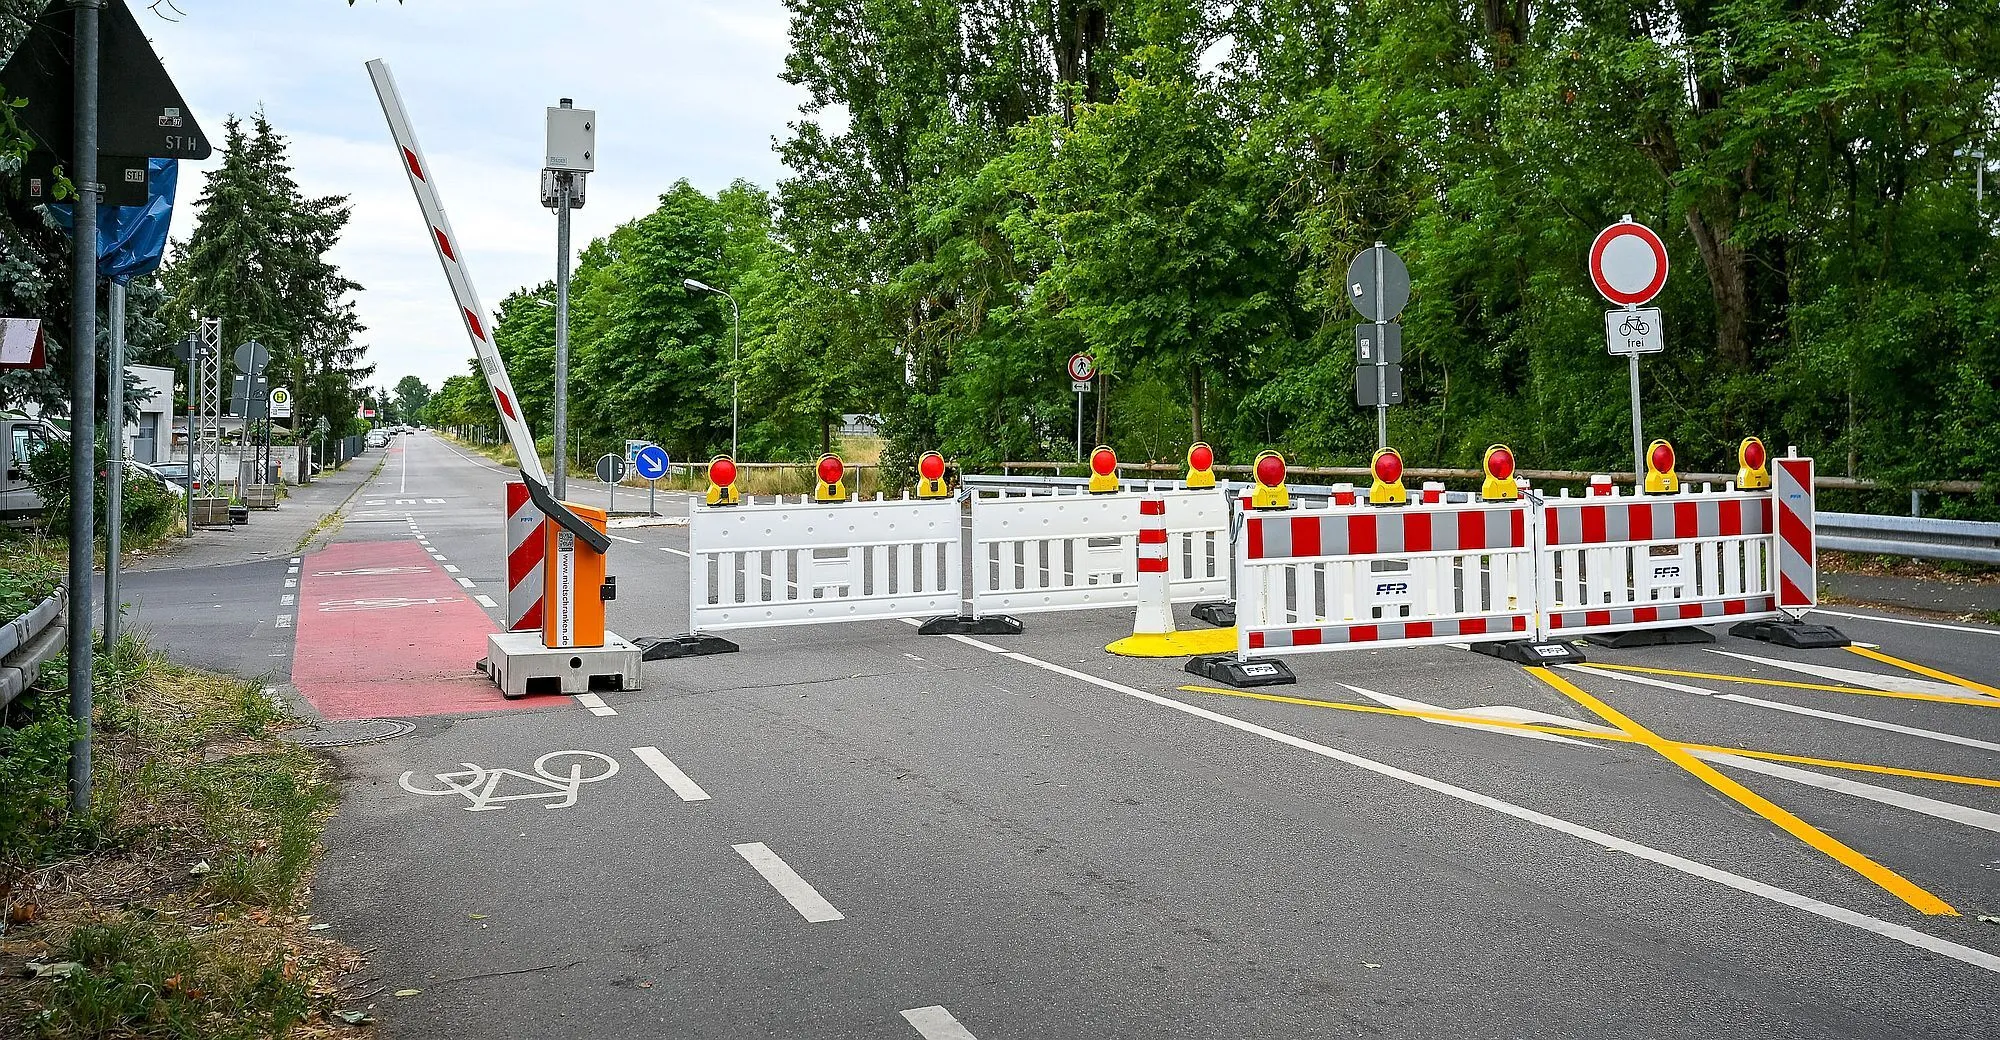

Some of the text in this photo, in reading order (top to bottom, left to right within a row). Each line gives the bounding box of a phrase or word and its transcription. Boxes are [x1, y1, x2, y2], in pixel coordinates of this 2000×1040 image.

[165, 135, 197, 151] ST H
[1627, 337, 1645, 348] frei
[1653, 566, 1680, 579] FFR
[1375, 582, 1408, 596] FFR
